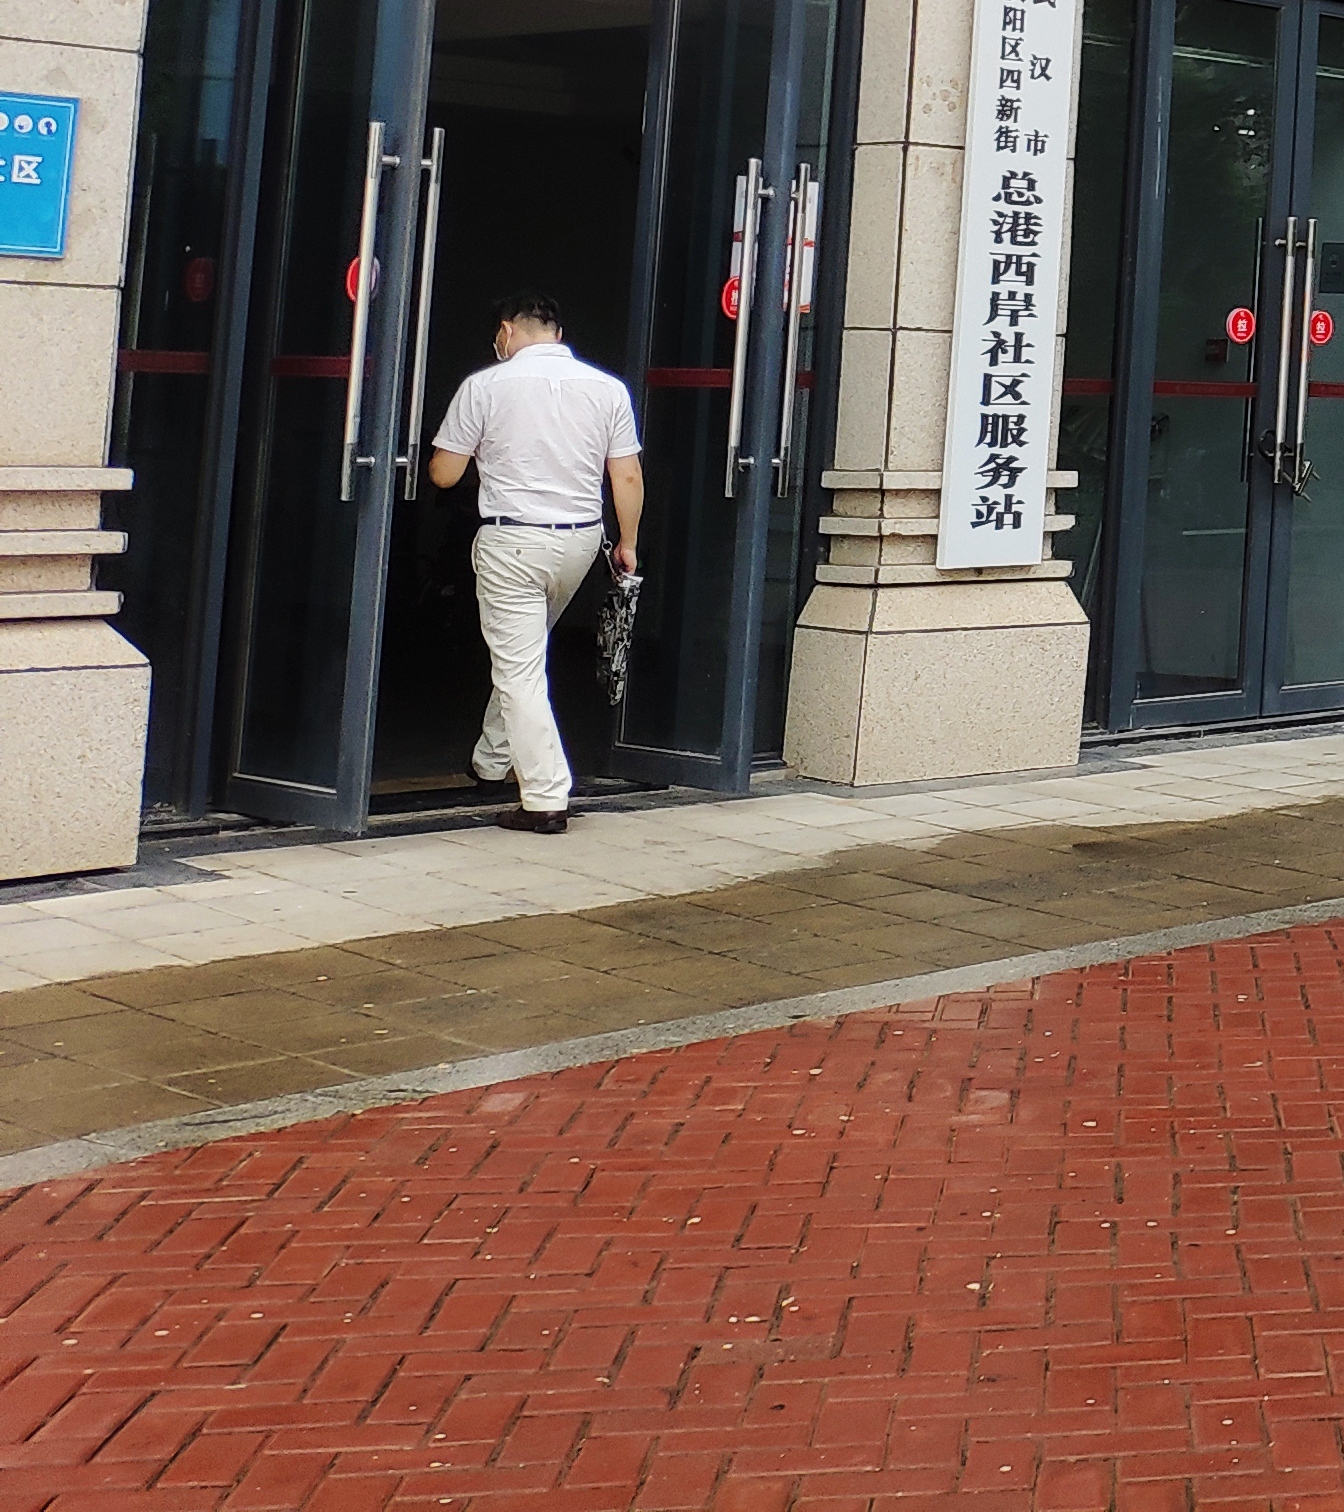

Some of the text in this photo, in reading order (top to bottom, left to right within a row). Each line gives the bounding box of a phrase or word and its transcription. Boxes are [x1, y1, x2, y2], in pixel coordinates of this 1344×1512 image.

[0, 155, 43, 185] 区
[970, 169, 1045, 531] 总港西岸社区服务站
